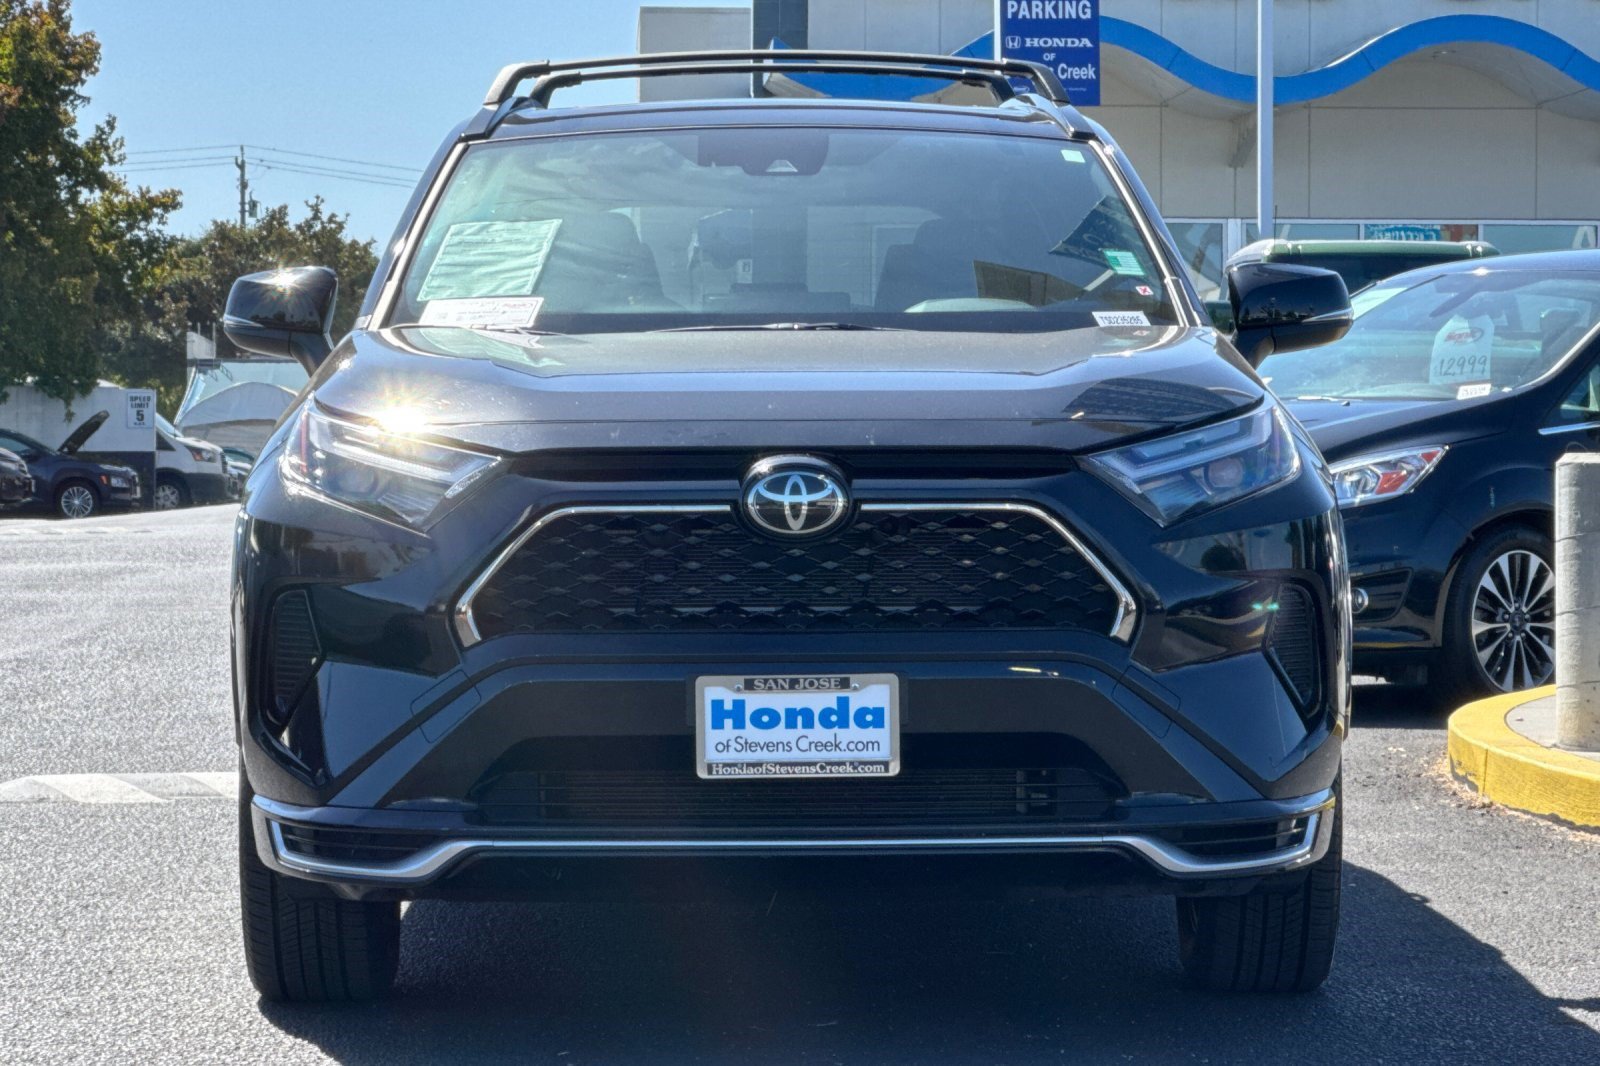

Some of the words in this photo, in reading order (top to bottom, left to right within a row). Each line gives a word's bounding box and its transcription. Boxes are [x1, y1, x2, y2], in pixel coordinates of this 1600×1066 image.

[1007, 0, 1092, 19] PARKING
[1024, 37, 1094, 48] HONDA
[1042, 52, 1056, 61] OF
[1057, 63, 1097, 80] Creek
[136, 409, 145, 422] 5
[753, 678, 790, 691] SAN
[794, 677, 841, 690] JOSE
[711, 696, 885, 730] Honda
[714, 738, 733, 754] of
[733, 735, 793, 753] Stevens
[795, 732, 881, 753] Creek.com
[712, 761, 885, 775] HondaofStevensCreek.com
